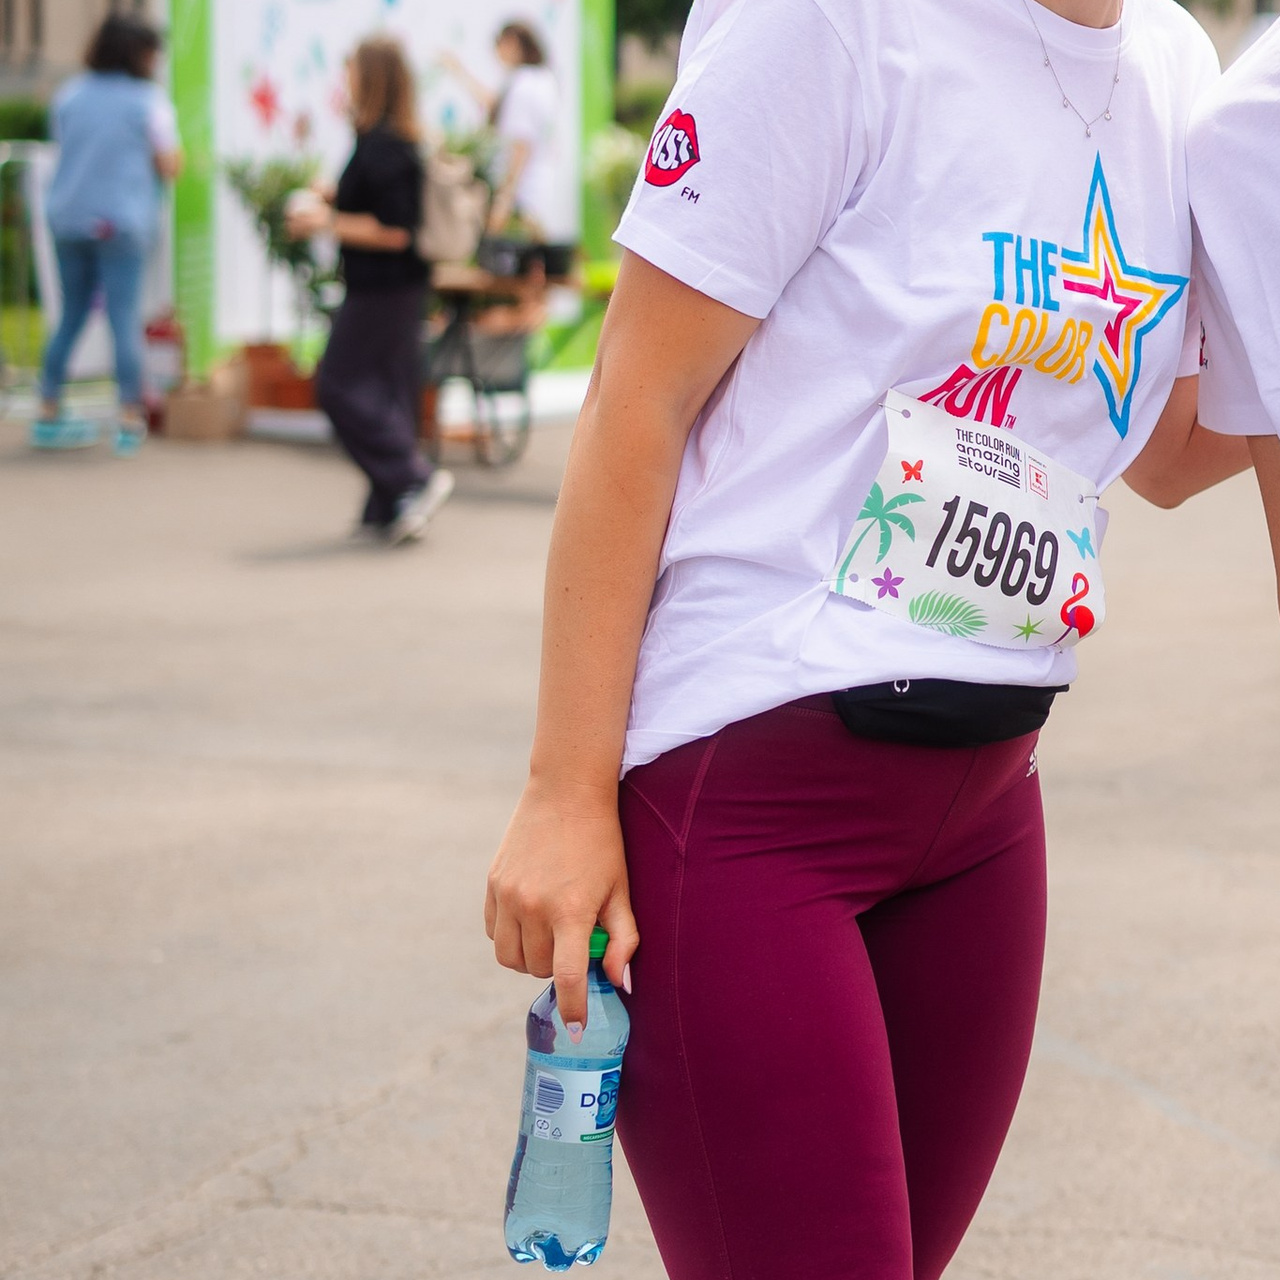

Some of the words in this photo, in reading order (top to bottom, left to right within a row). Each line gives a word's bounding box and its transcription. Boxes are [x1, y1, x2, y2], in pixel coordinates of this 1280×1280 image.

[681, 186, 701, 204] FM
[982, 231, 1060, 312] THE
[971, 303, 1094, 385] COLOR
[956, 428, 974, 444] THE
[975, 432, 1004, 453] COLOR
[956, 443, 1020, 477] amazing
[968, 457, 997, 478] tour
[925, 495, 1059, 606] 15969
